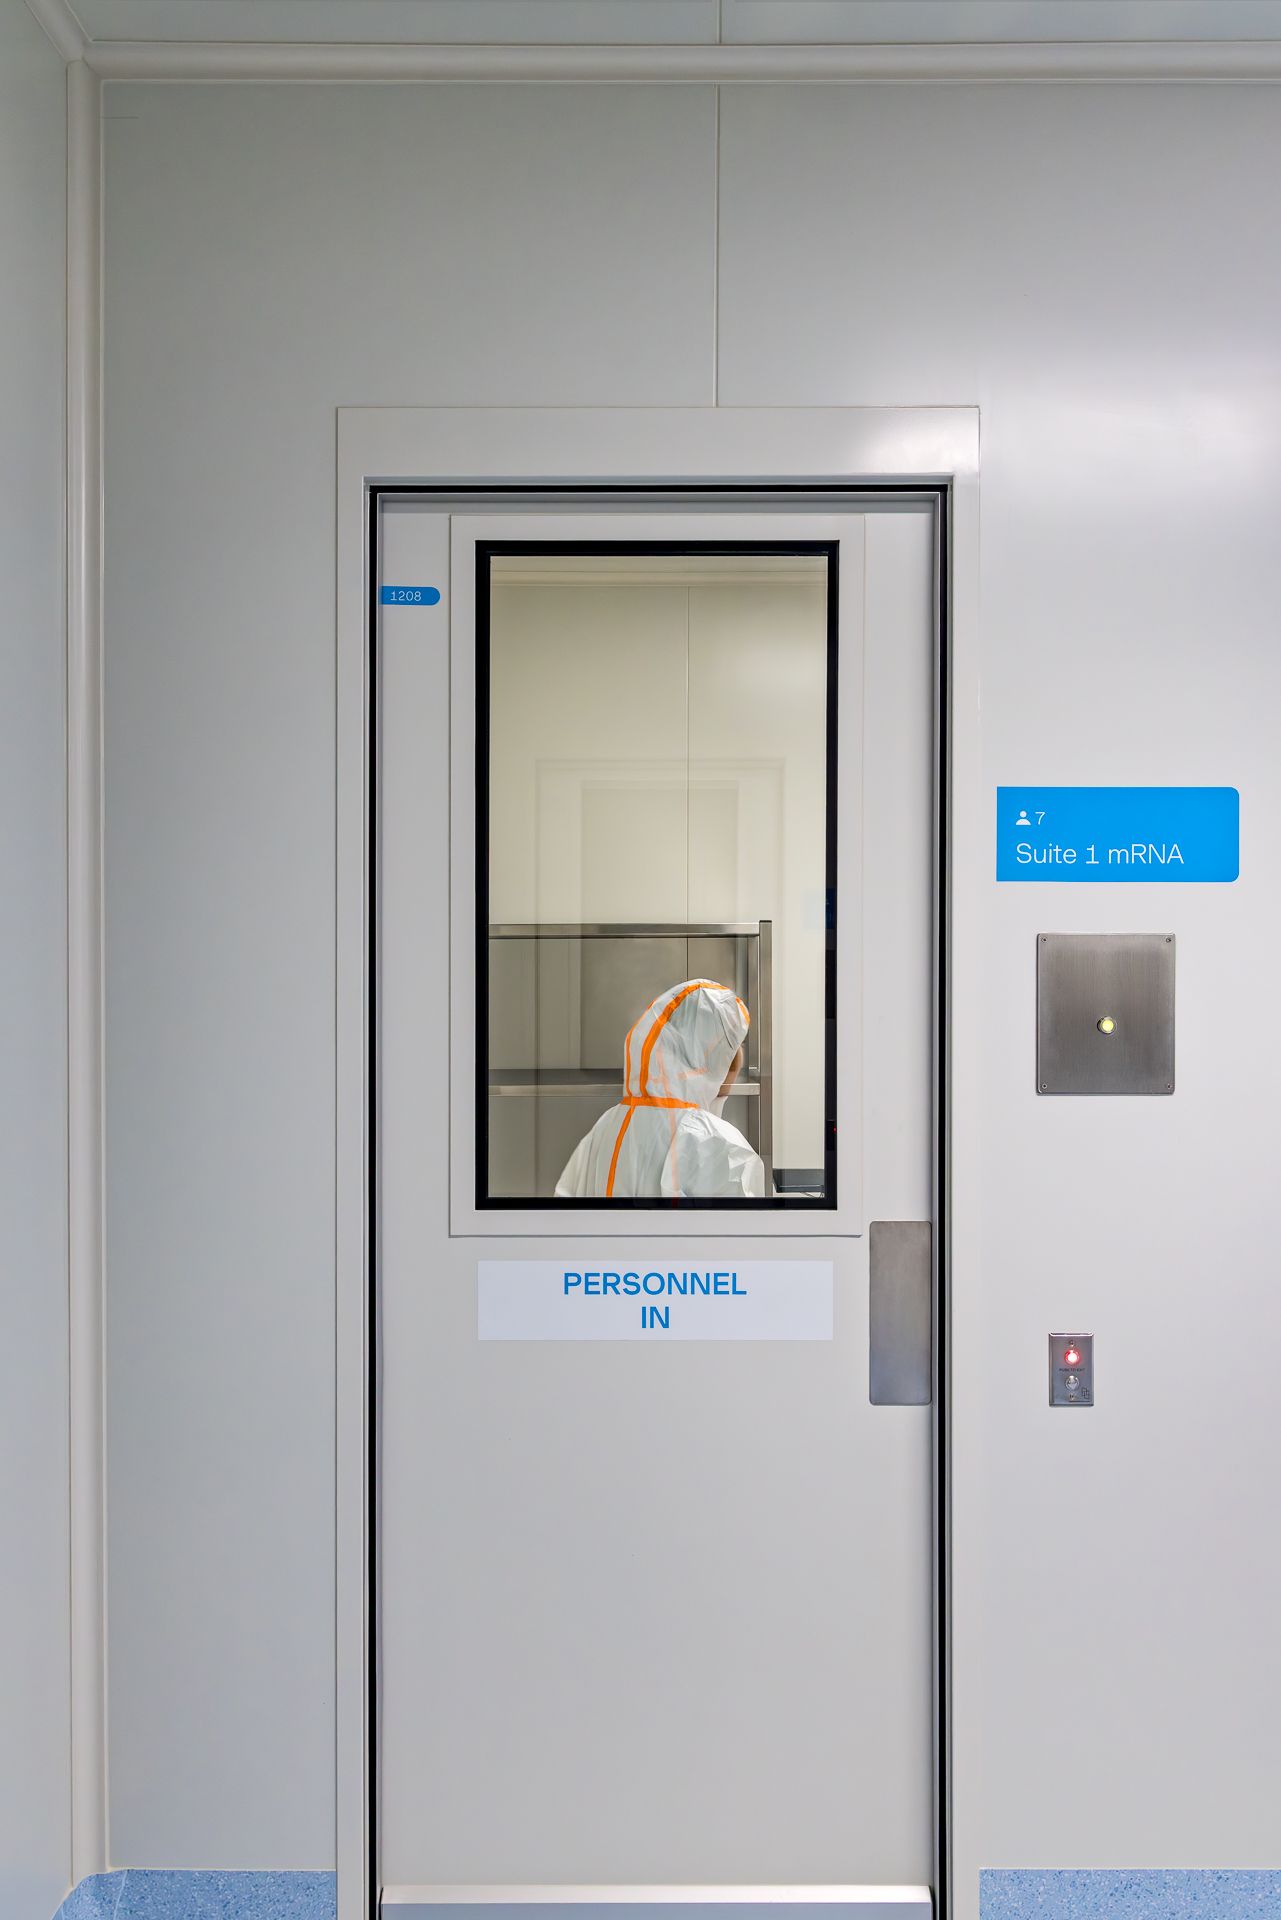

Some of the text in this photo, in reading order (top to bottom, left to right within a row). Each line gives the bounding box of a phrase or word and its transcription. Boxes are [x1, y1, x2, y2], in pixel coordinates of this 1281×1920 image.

[390, 591, 421, 602] 1208
[1035, 811, 1046, 826] 7
[1016, 842, 1185, 865] Suite 1 mRNA
[563, 1271, 748, 1296] PERSONNEL
[641, 1305, 670, 1330] IN
